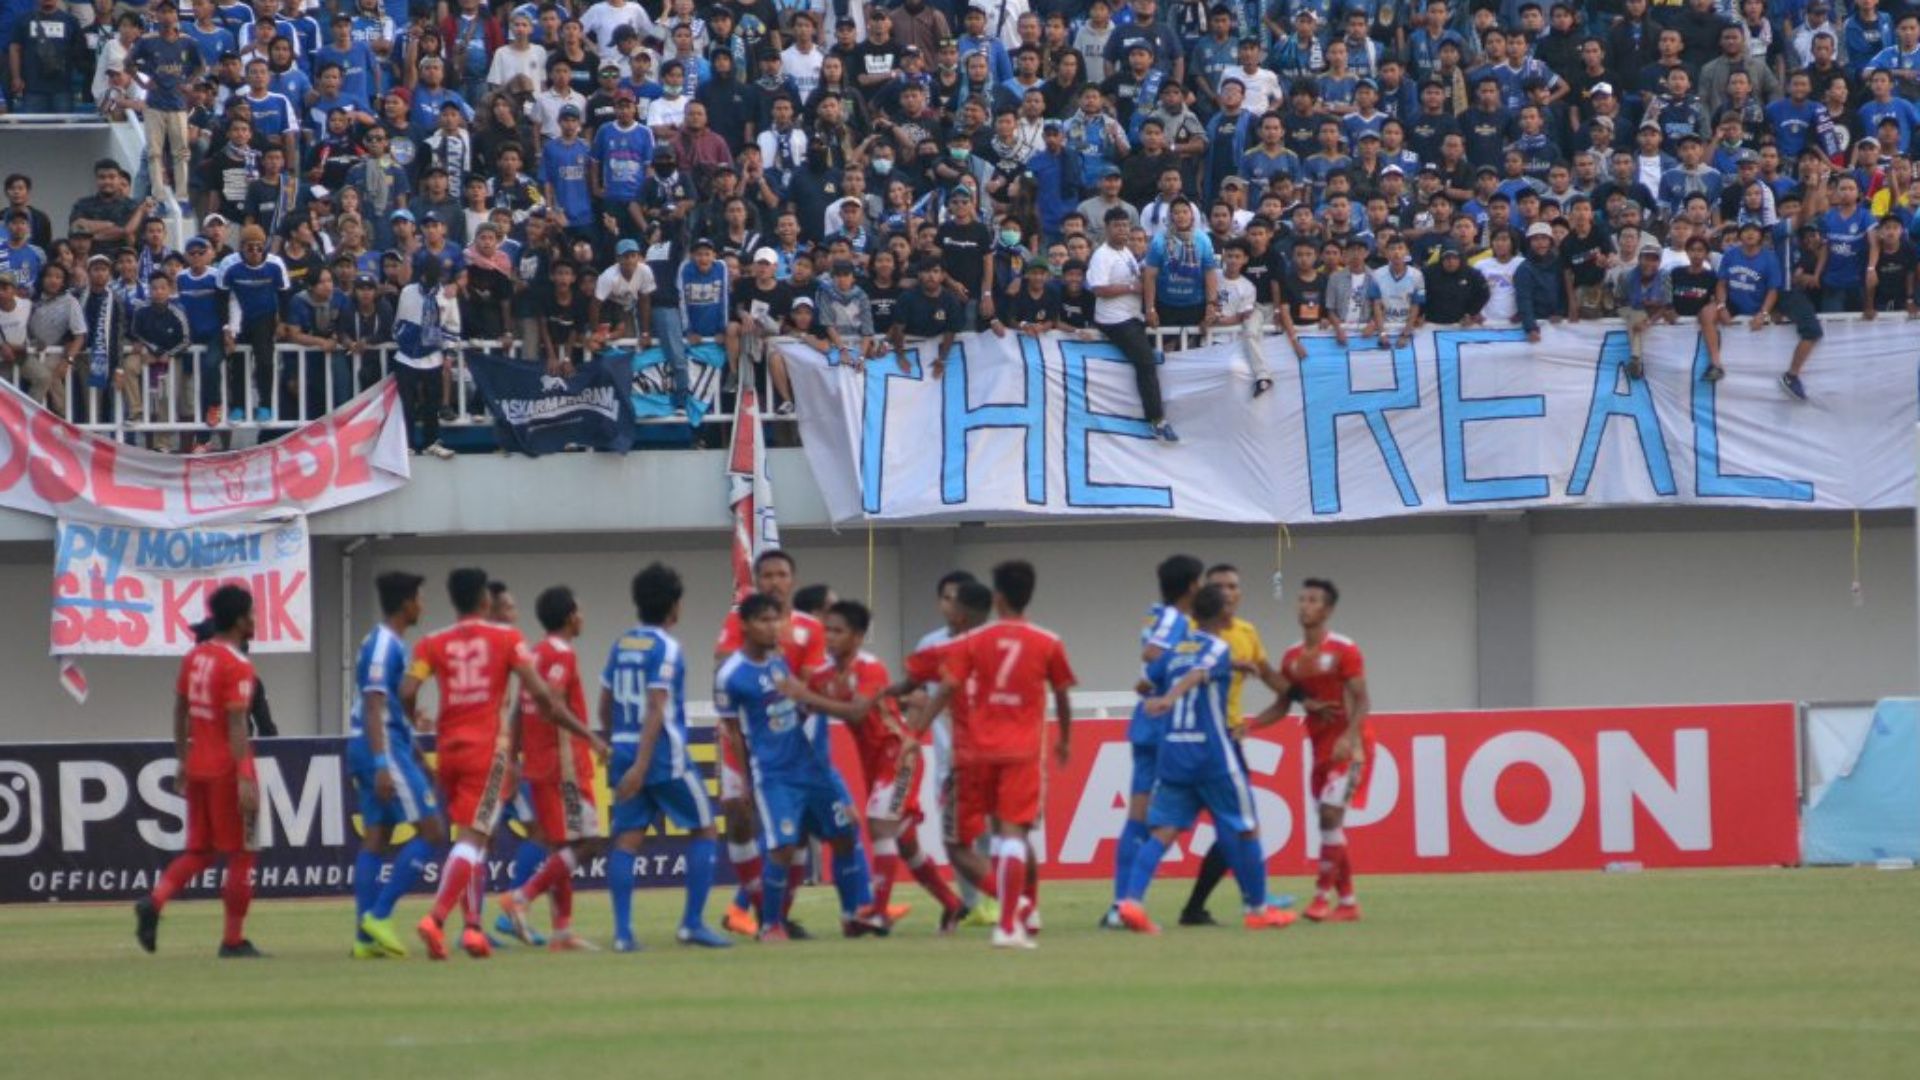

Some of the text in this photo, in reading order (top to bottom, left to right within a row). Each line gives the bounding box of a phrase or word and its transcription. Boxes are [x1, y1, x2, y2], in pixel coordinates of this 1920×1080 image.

[828, 329, 1814, 514] THE REAL
[135, 527, 262, 569] MONDAY
[162, 570, 306, 643] KIK
[996, 639, 1021, 689] 7
[613, 669, 646, 723] 44
